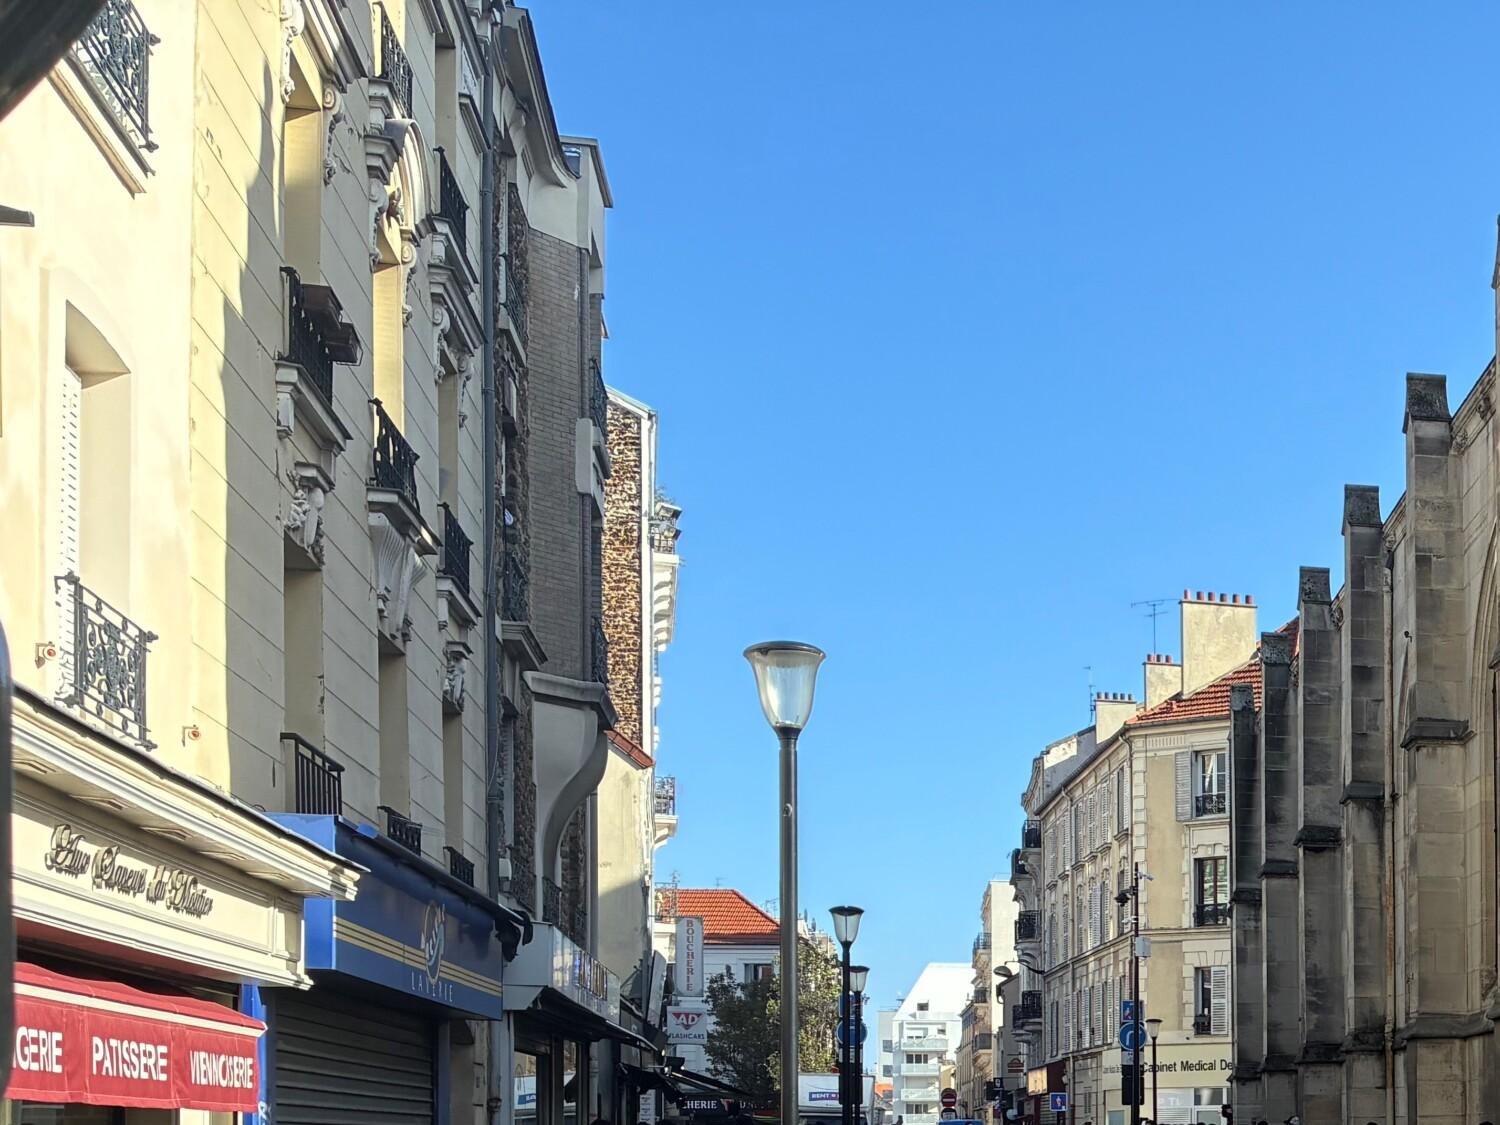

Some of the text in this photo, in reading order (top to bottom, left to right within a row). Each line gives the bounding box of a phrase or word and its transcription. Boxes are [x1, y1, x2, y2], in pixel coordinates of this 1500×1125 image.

[686, 920, 695, 992] BOUCHERIE
[411, 971, 453, 1003] LAVERIE
[679, 1013, 698, 1025] AD
[14, 1026, 254, 1089] GERIE PATISSERIE VIENNOISERIE
[1143, 1062, 1177, 1073] Cabinet
